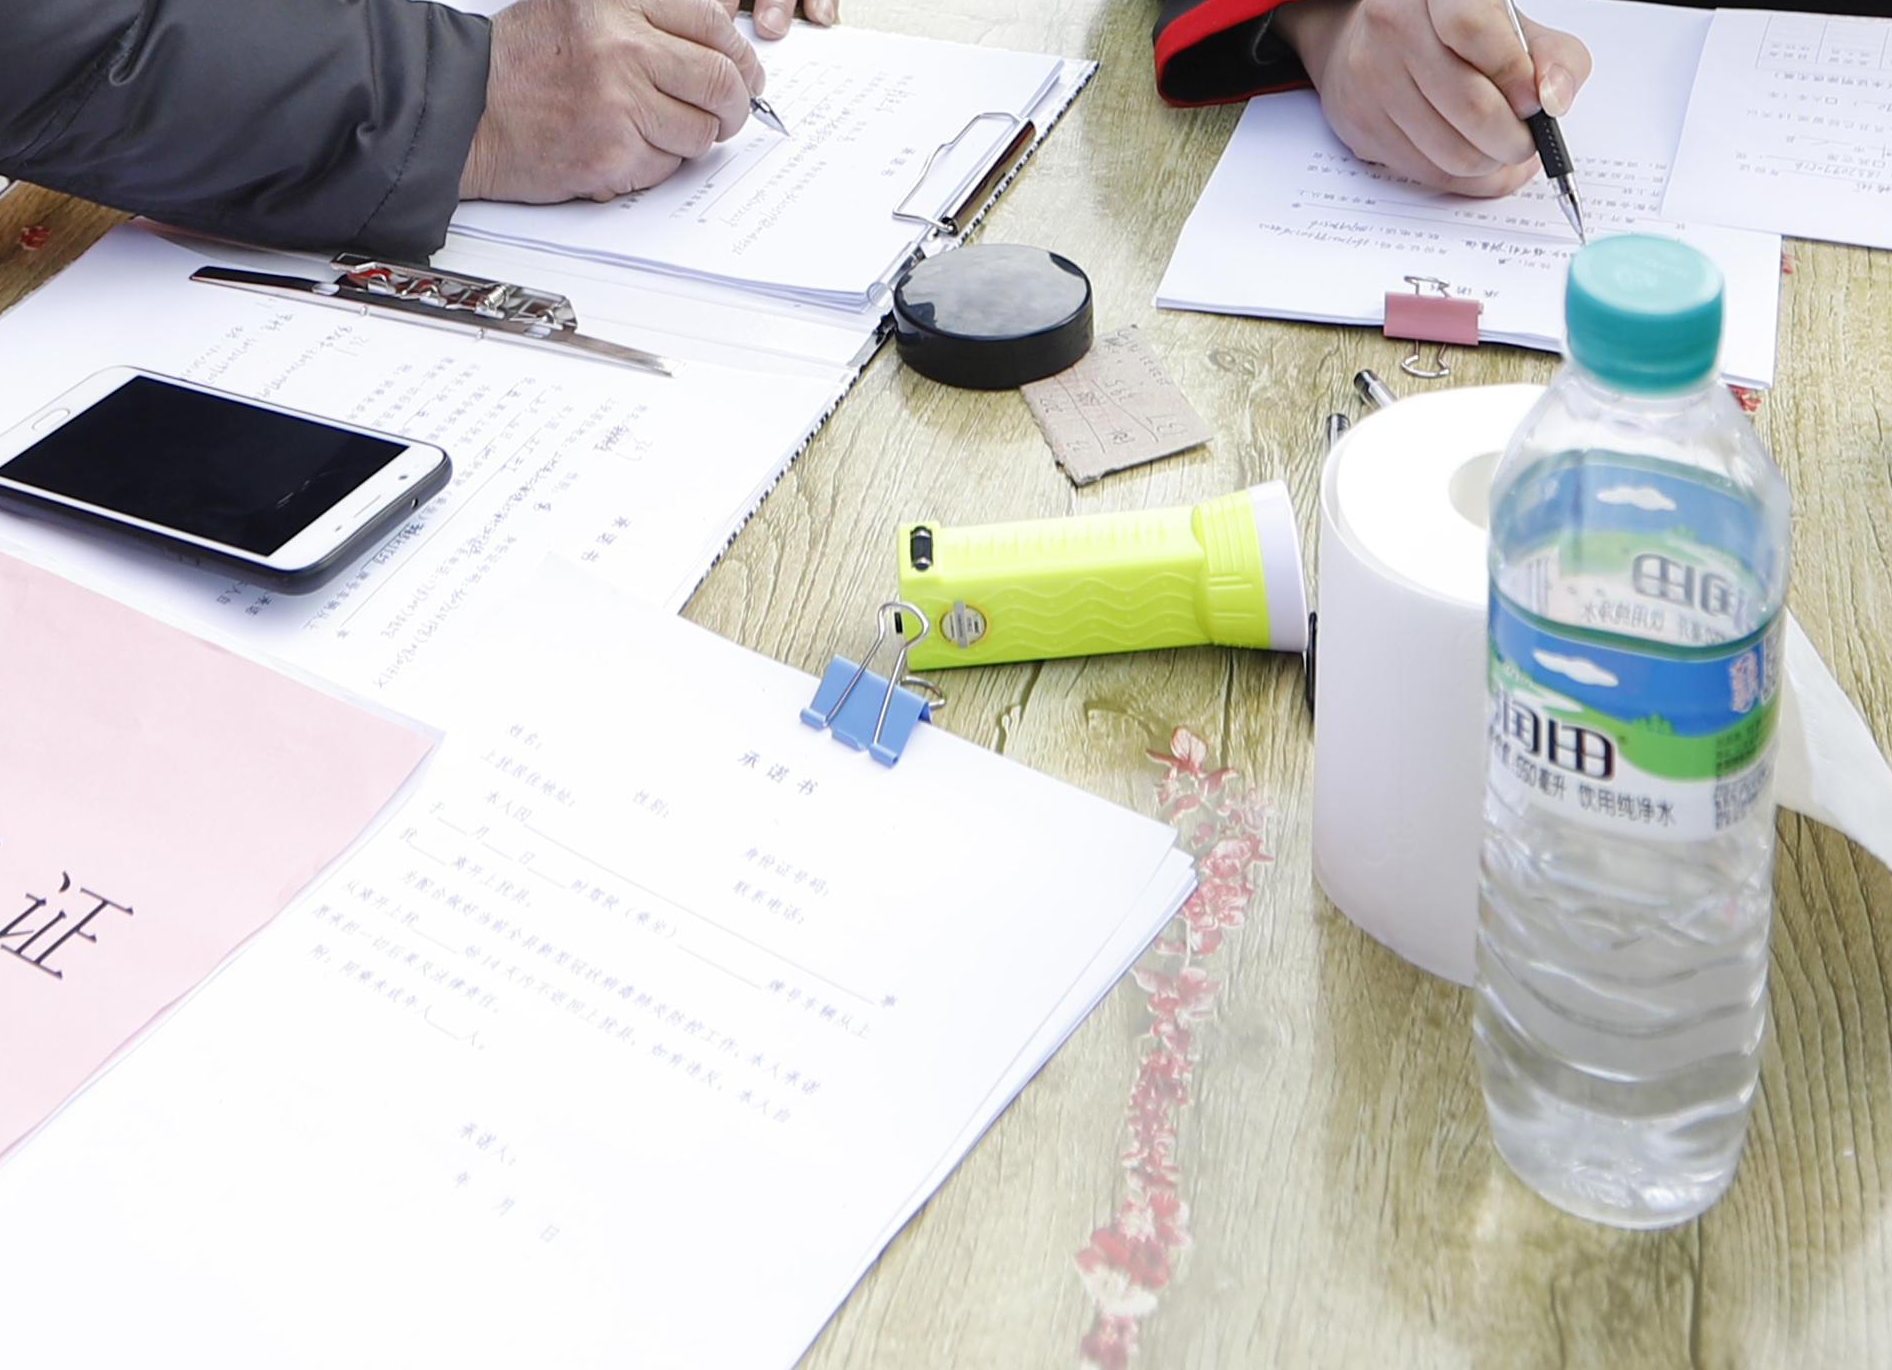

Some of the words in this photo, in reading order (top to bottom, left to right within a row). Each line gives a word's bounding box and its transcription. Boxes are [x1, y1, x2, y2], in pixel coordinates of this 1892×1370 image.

[580, 515, 632, 563] 承诺书
[737, 750, 819, 796] 承诺书
[1579, 782, 1676, 827] 饮用纯净水
[744, 846, 830, 898] 身份证号码：
[732, 879, 805, 926] 联系电话：
[766, 979, 869, 1039] 牌号车辆从上
[457, 1122, 517, 1167] 承诺人：
